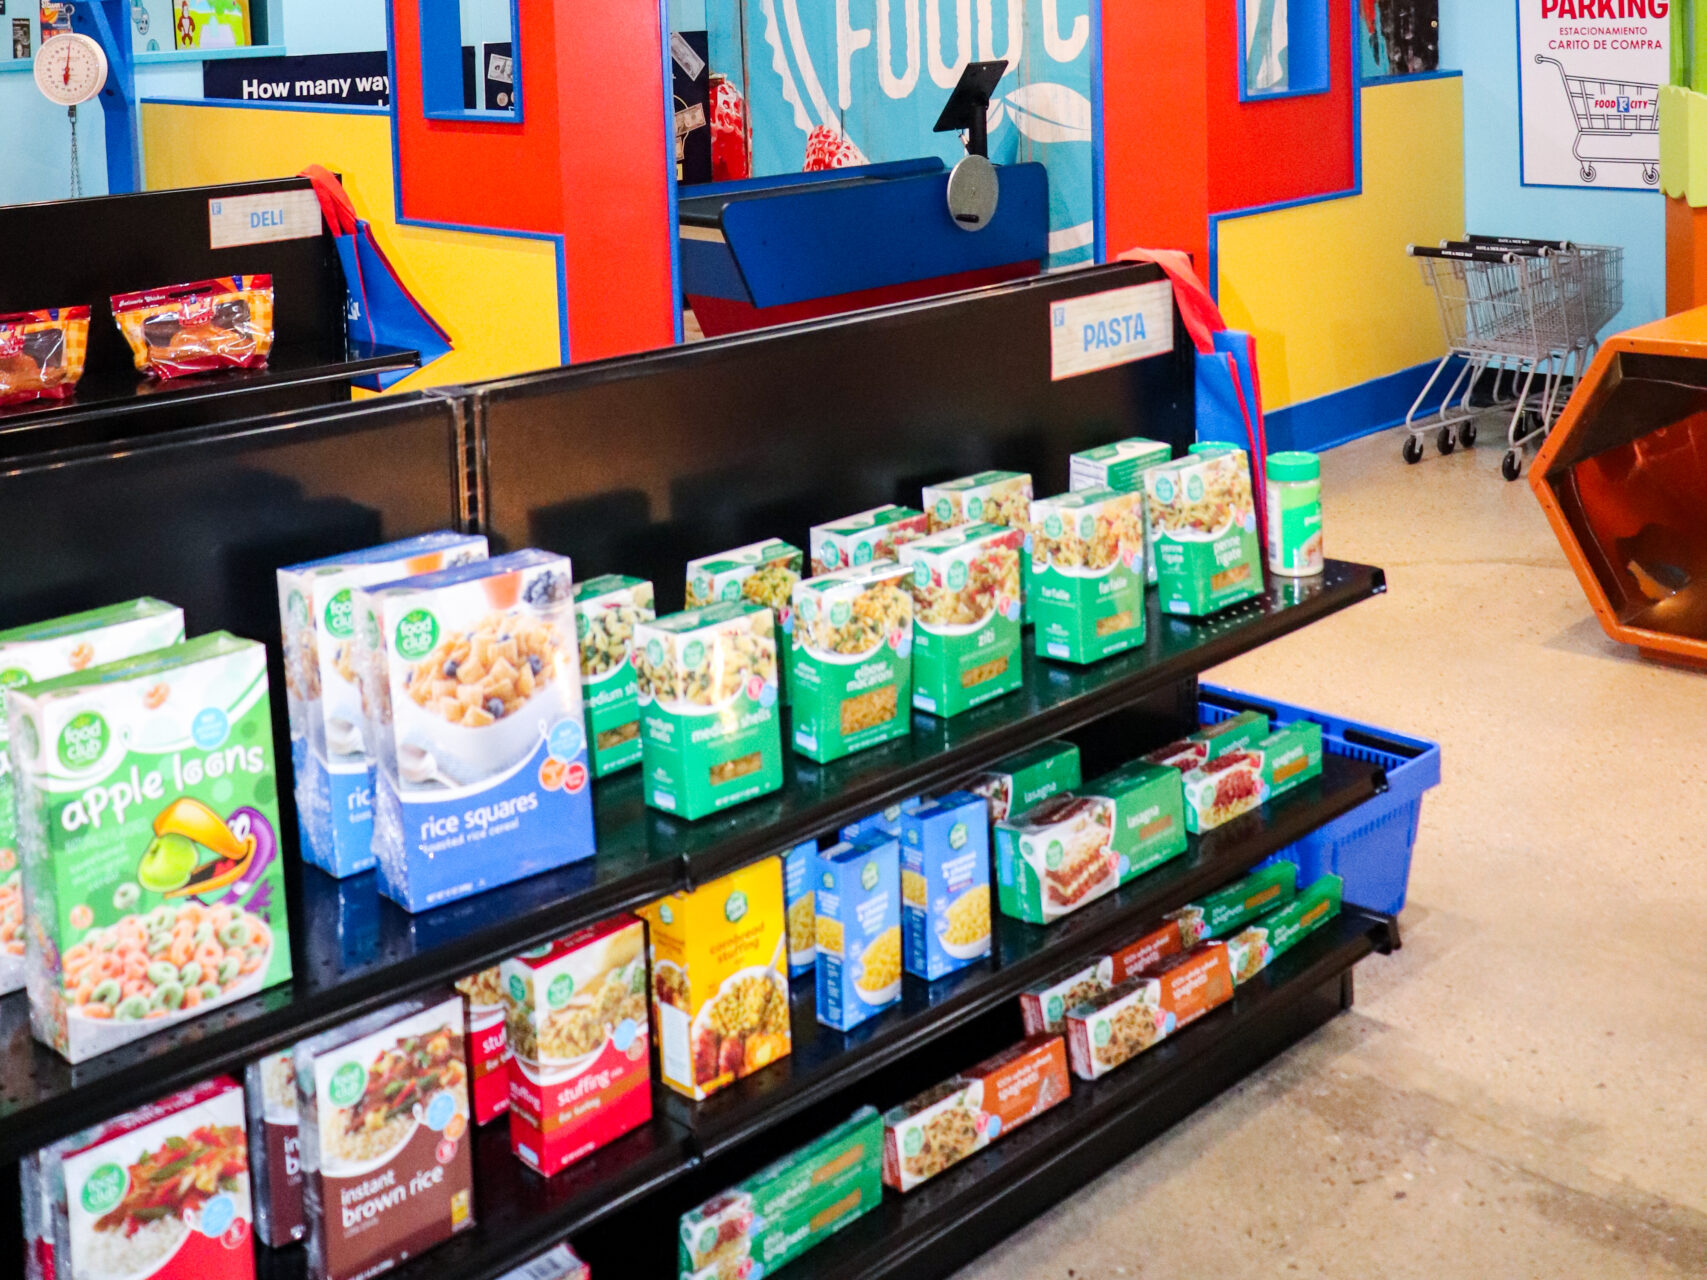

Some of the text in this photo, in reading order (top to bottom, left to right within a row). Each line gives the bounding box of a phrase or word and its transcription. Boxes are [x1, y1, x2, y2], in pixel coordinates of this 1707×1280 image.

[1559, 26, 1648, 36] ESTACIONAMIENTO
[1548, 39, 1663, 50] CARITO DE COMPRA
[242, 75, 389, 100] How many way
[1594, 99, 1616, 108] FOOD
[1630, 100, 1648, 109] CITY
[250, 209, 283, 229] DELI
[1083, 312, 1146, 352] PASTA
[401, 615, 432, 638] food
[978, 629, 996, 647] ziti
[402, 631, 432, 651] club
[64, 721, 101, 743] food
[66, 738, 100, 759] club
[61, 765, 164, 831] apple
[174, 745, 264, 792] loons
[348, 786, 373, 811] ric
[1023, 781, 1057, 804] lasagna
[420, 791, 538, 841] rice squares
[1126, 804, 1160, 829] lasagna
[557, 1069, 611, 1107] stuffing
[340, 1168, 395, 1206] instant
[341, 1185, 407, 1228] brown
[409, 1166, 444, 1196] rice
